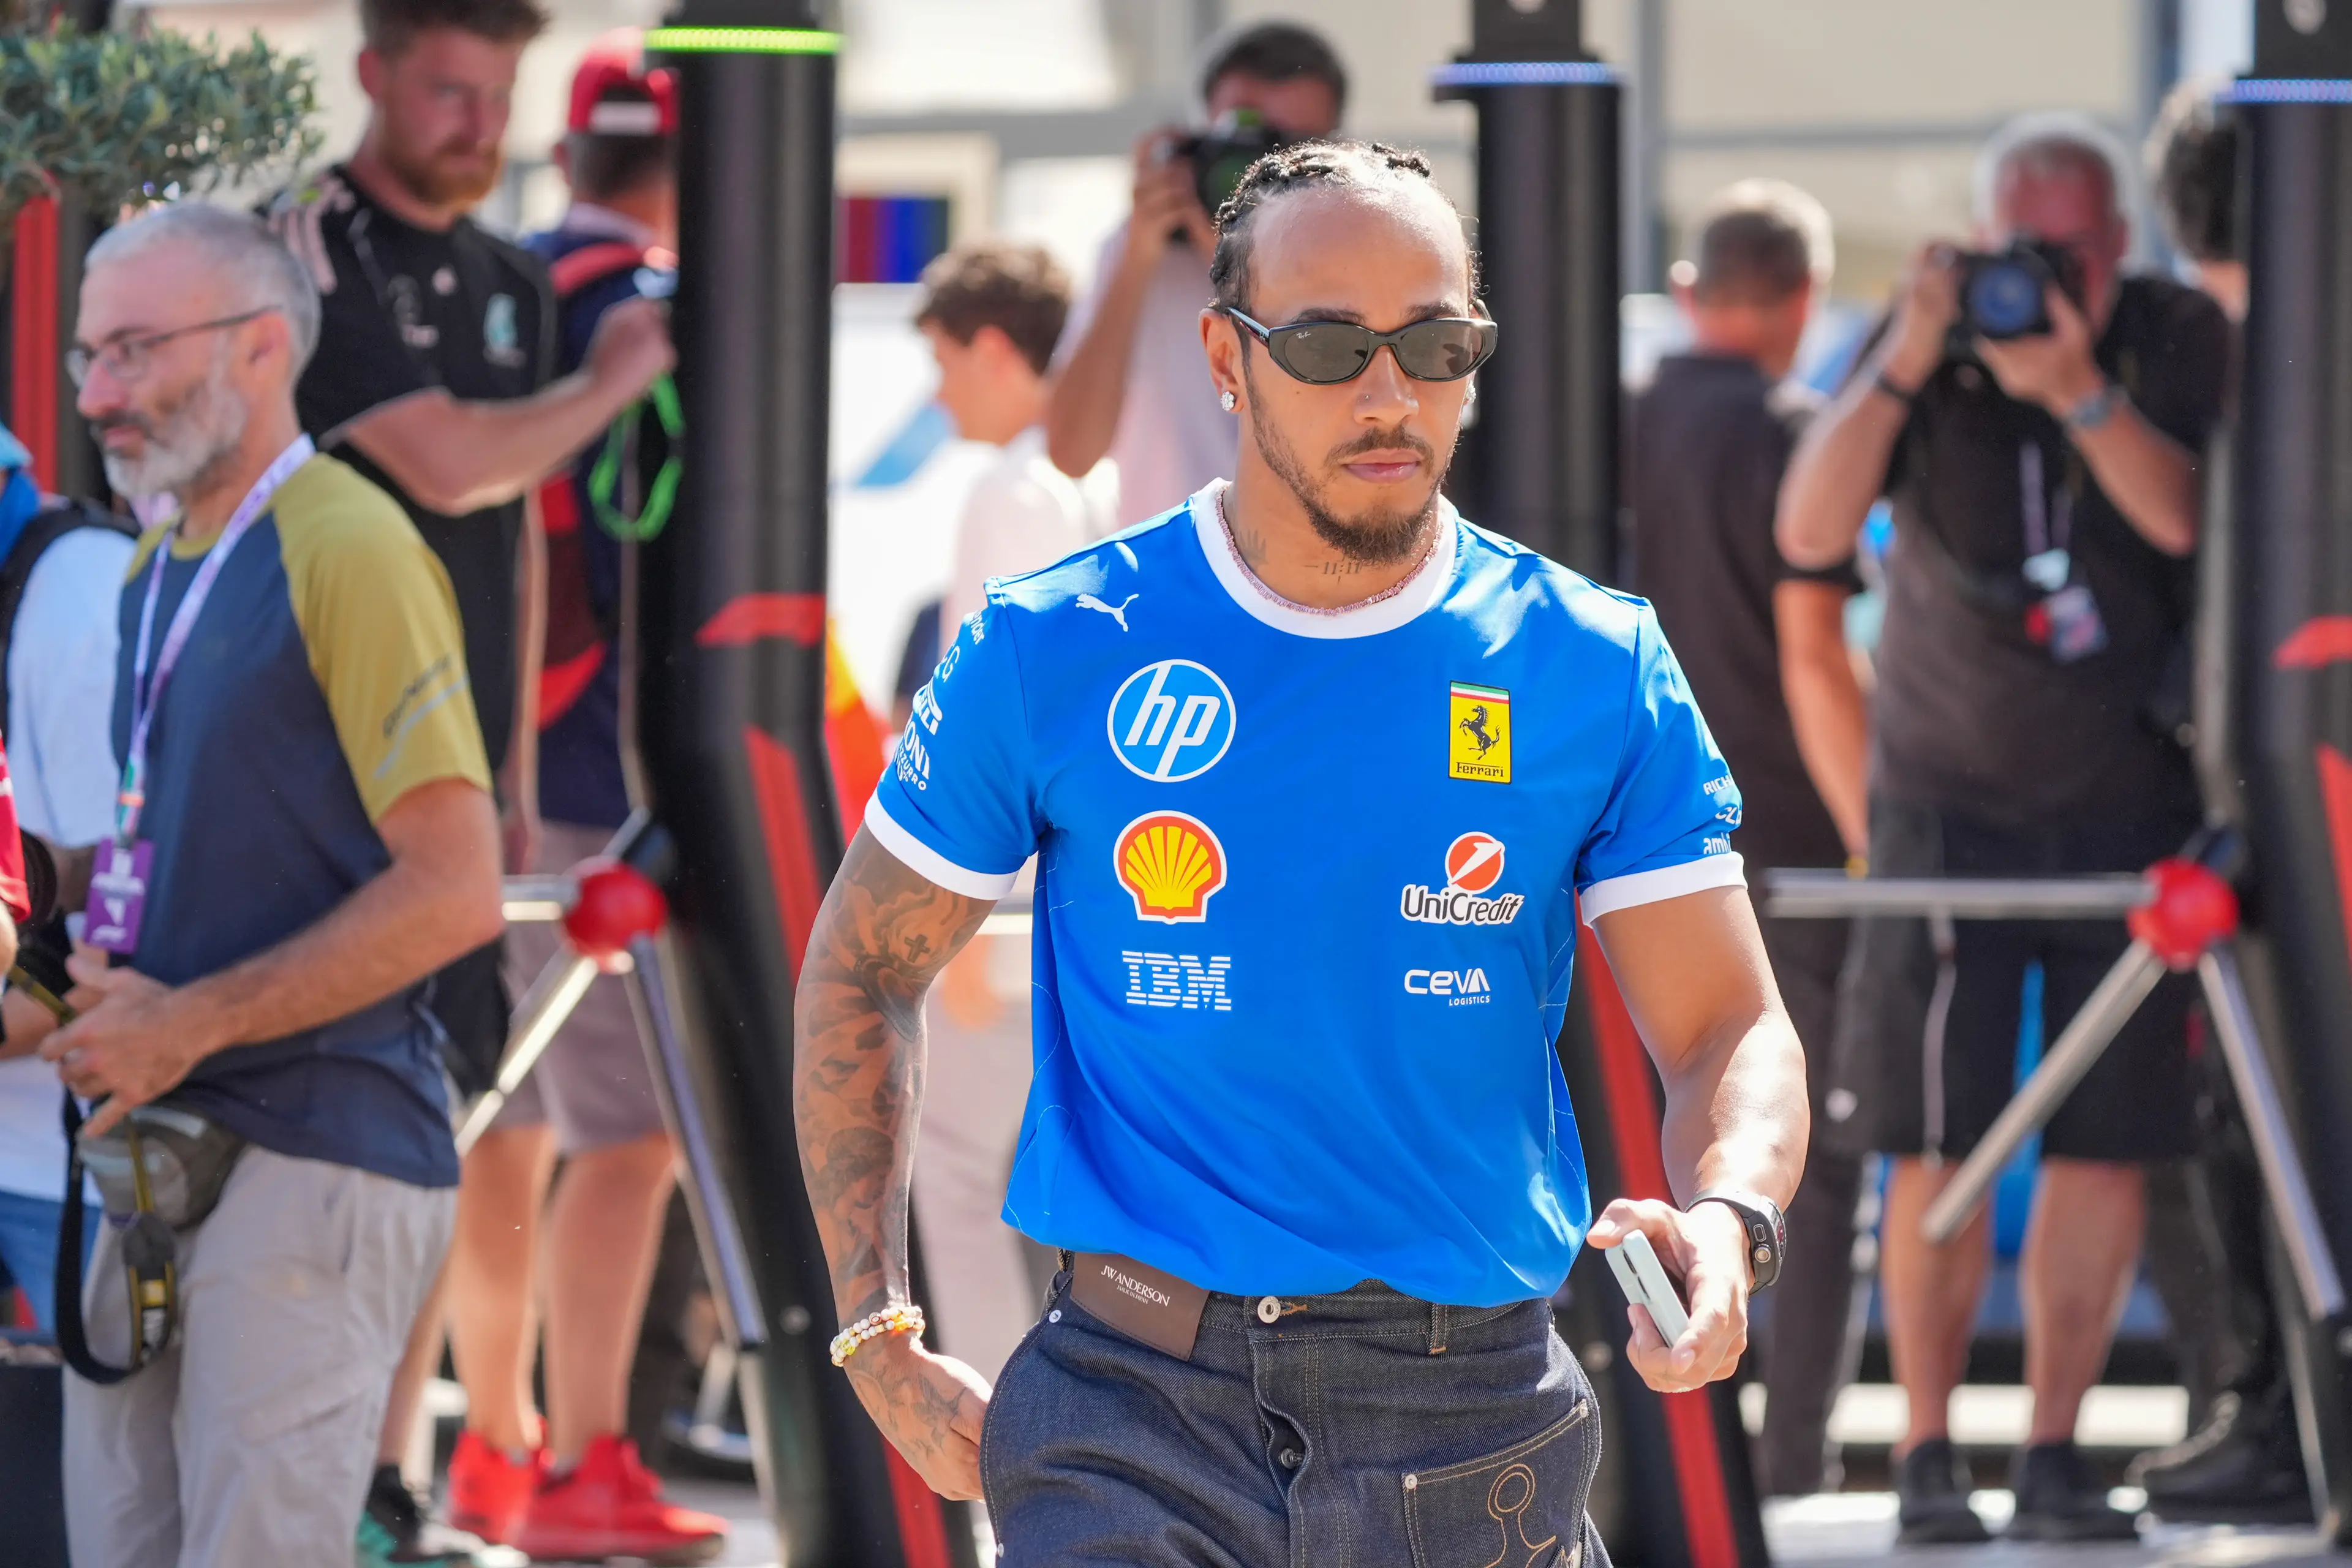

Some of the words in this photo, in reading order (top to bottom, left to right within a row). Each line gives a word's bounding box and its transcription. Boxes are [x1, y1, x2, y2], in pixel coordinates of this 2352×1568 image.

[1123, 663, 1221, 778] hp
[1456, 761, 1504, 777] Ferrari
[1403, 887, 1525, 922] UniCredit
[1121, 950, 1232, 1011] IBM
[1449, 995, 1490, 1006] LOGISTICS
[1101, 1265, 1117, 1280] JW
[1115, 1272, 1170, 1307] ANDERSON
[1117, 1285, 1130, 1295] MADE
[1134, 1294, 1149, 1305] JAPAN
